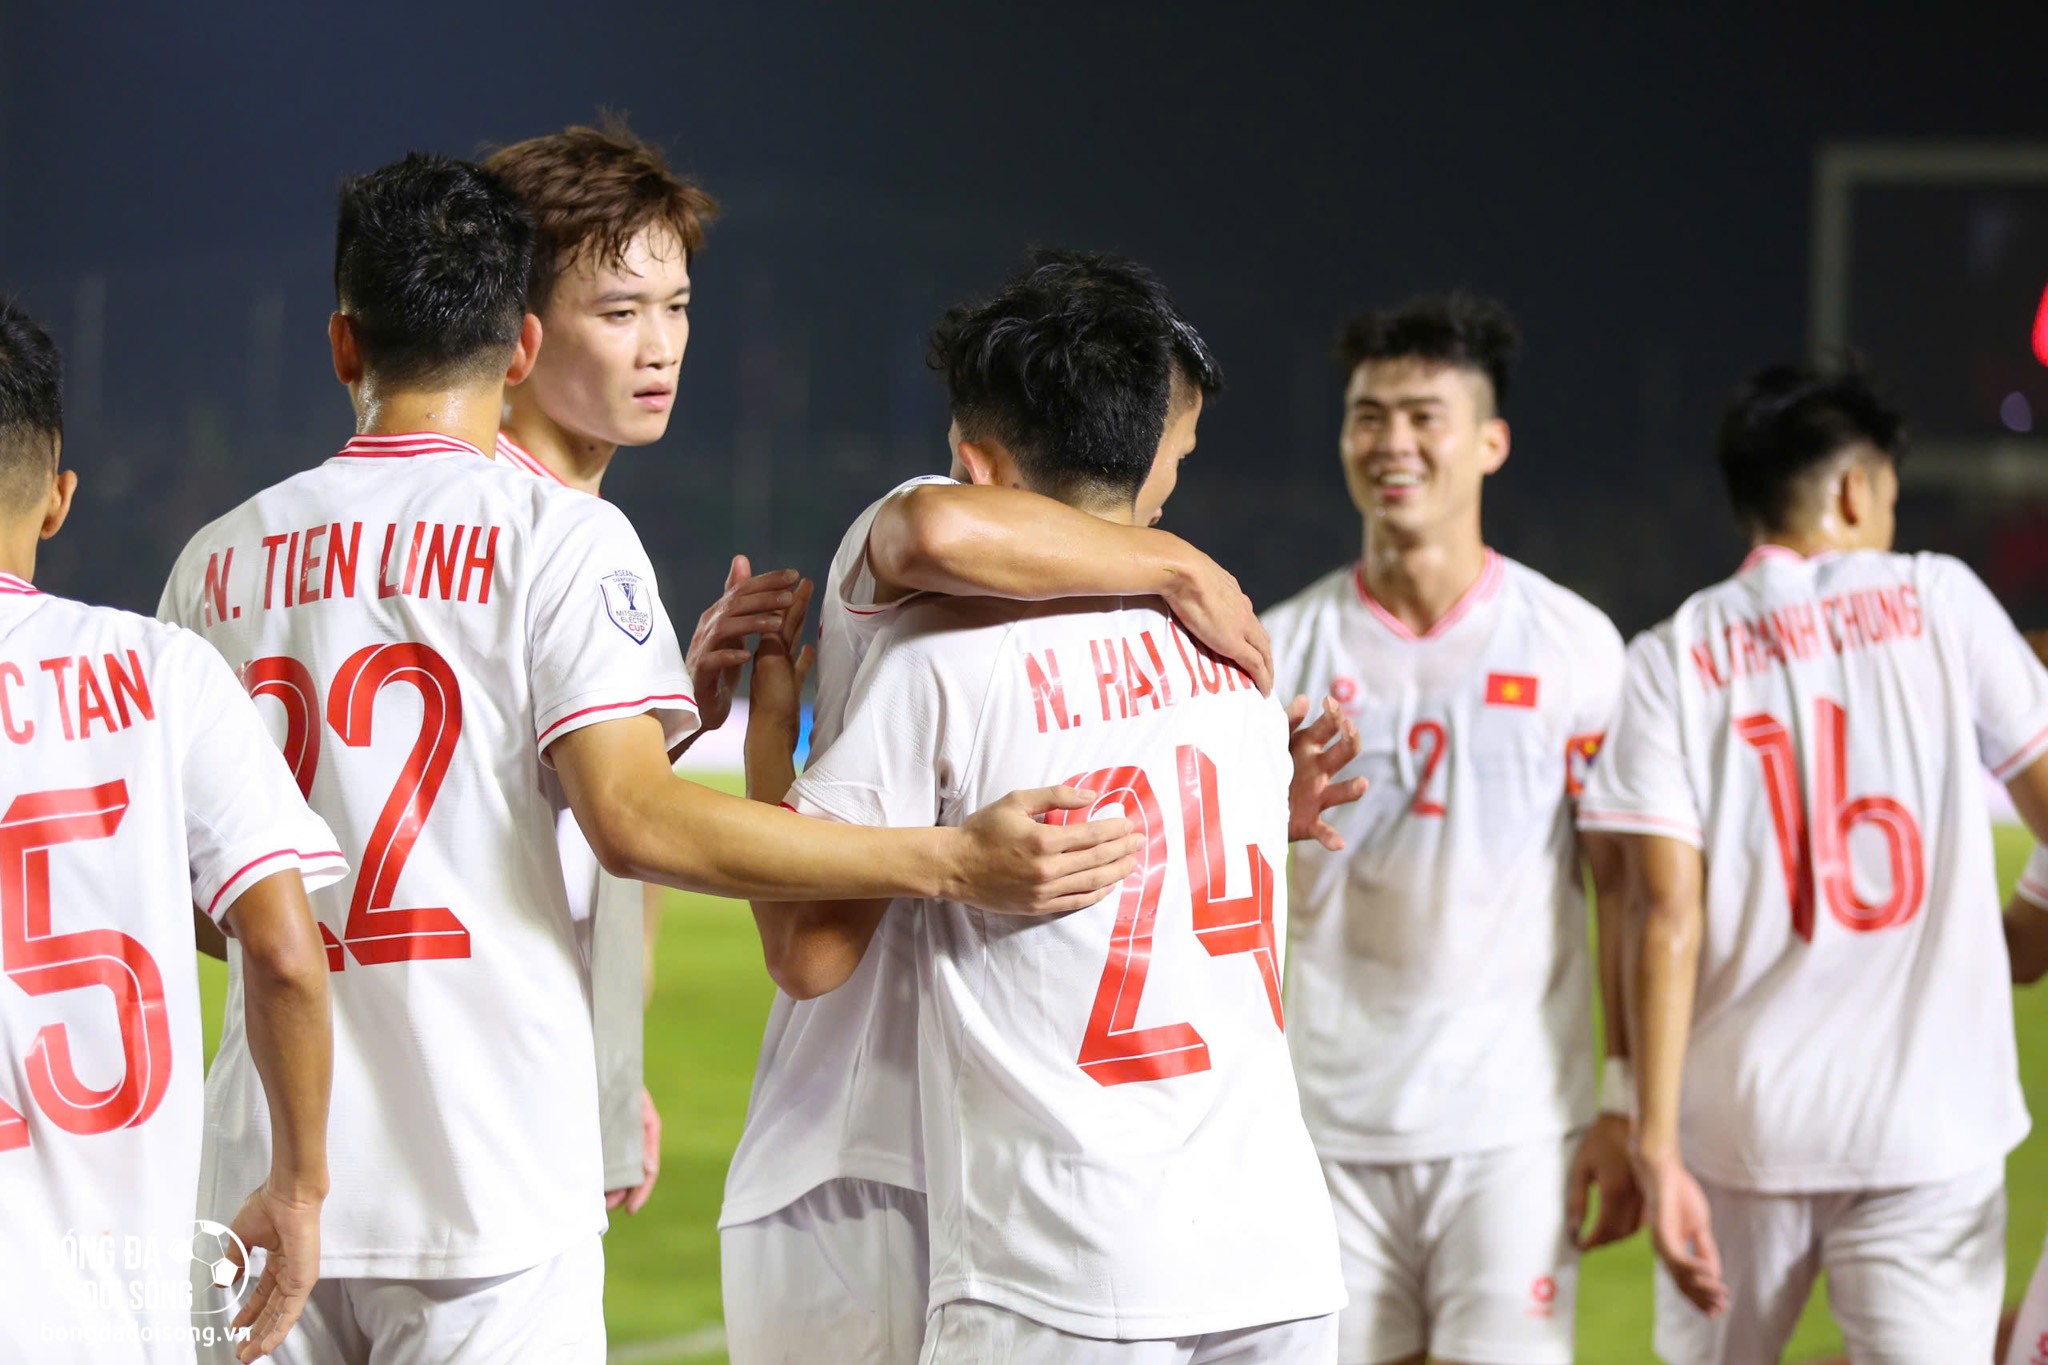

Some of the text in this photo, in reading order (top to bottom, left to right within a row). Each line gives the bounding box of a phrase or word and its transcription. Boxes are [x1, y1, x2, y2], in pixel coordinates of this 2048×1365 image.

[205, 521, 500, 627] N. TIEN LINH
[1821, 583, 1922, 656] CHUNG
[628, 623, 646, 632] CUP
[39, 649, 156, 741] TAN
[1024, 648, 1081, 733] N.
[1089, 630, 1174, 721] HAI
[1407, 719, 1449, 817] 2
[1734, 696, 1926, 942] 16
[0, 779, 173, 1152] 5
[1045, 744, 1285, 1087] 24
